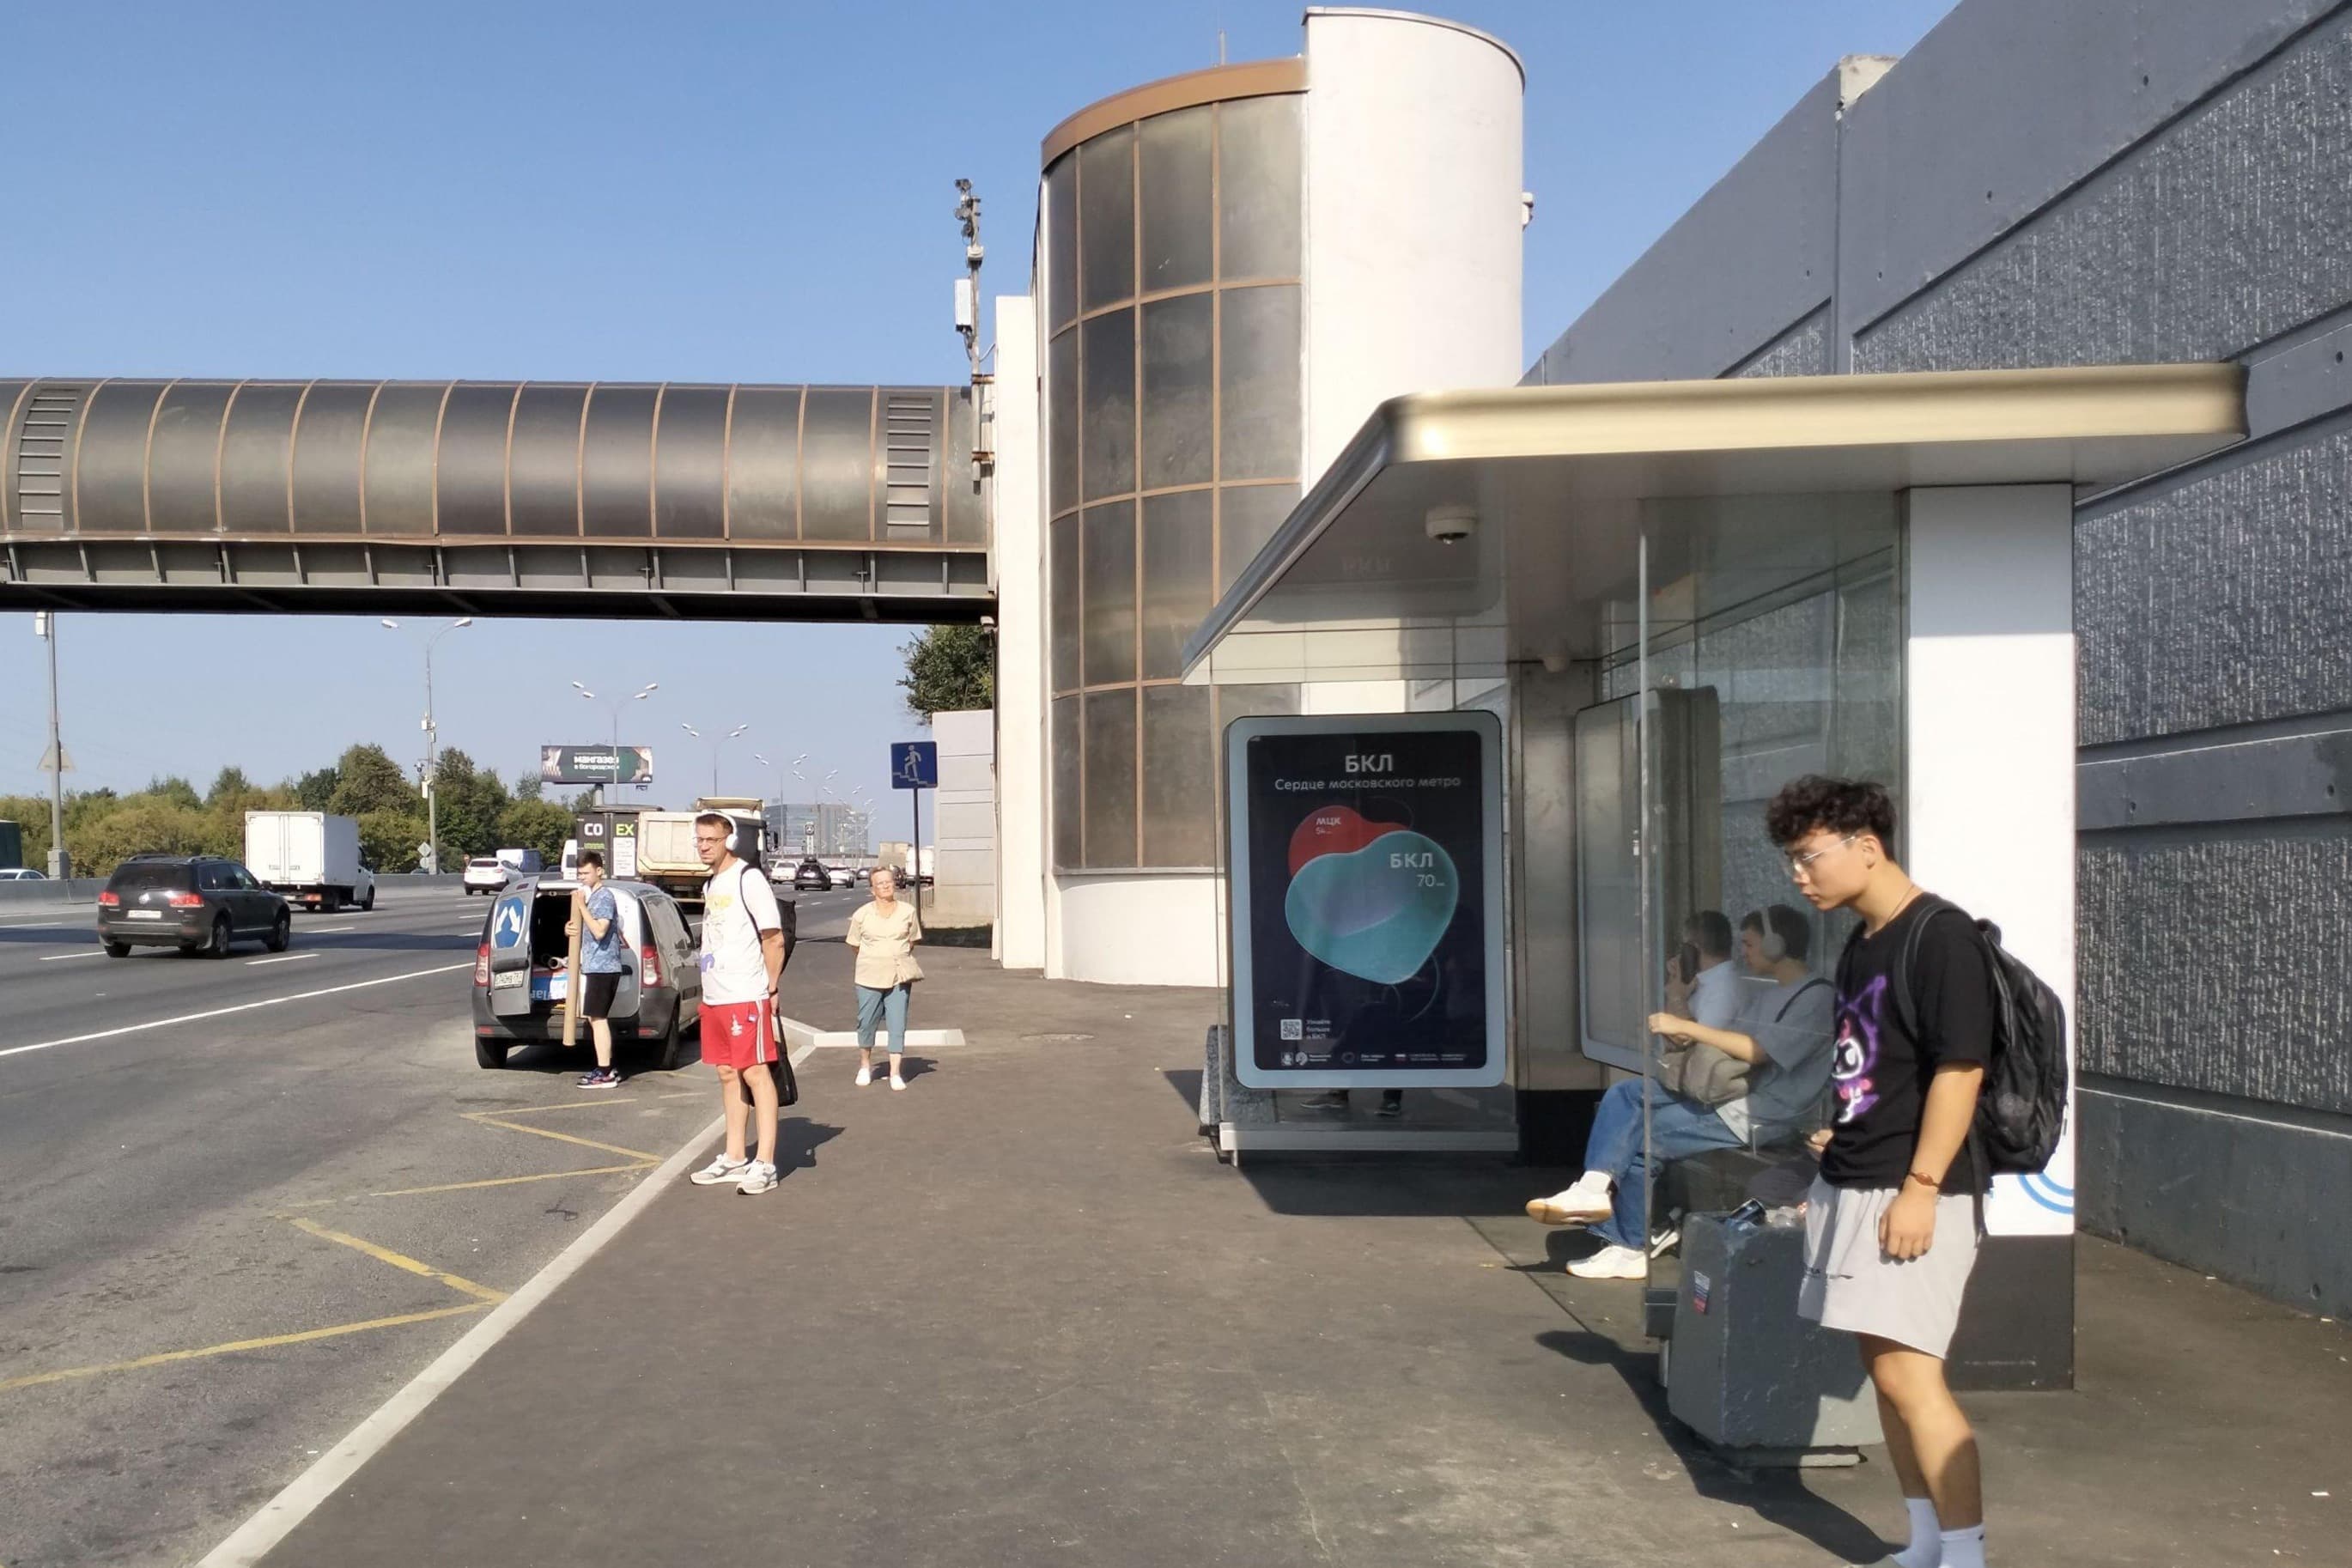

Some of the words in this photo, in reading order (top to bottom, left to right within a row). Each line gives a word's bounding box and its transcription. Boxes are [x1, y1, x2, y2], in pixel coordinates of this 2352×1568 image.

[1345, 755, 1394, 773] БКЛ
[1274, 779, 1325, 793] Сердце
[1328, 779, 1414, 789] московского
[1418, 776, 1462, 787] метро
[584, 823, 604, 836] CO
[616, 824, 635, 836] EX
[1389, 853, 1433, 868] БКЛ
[1416, 874, 1435, 887] 70
